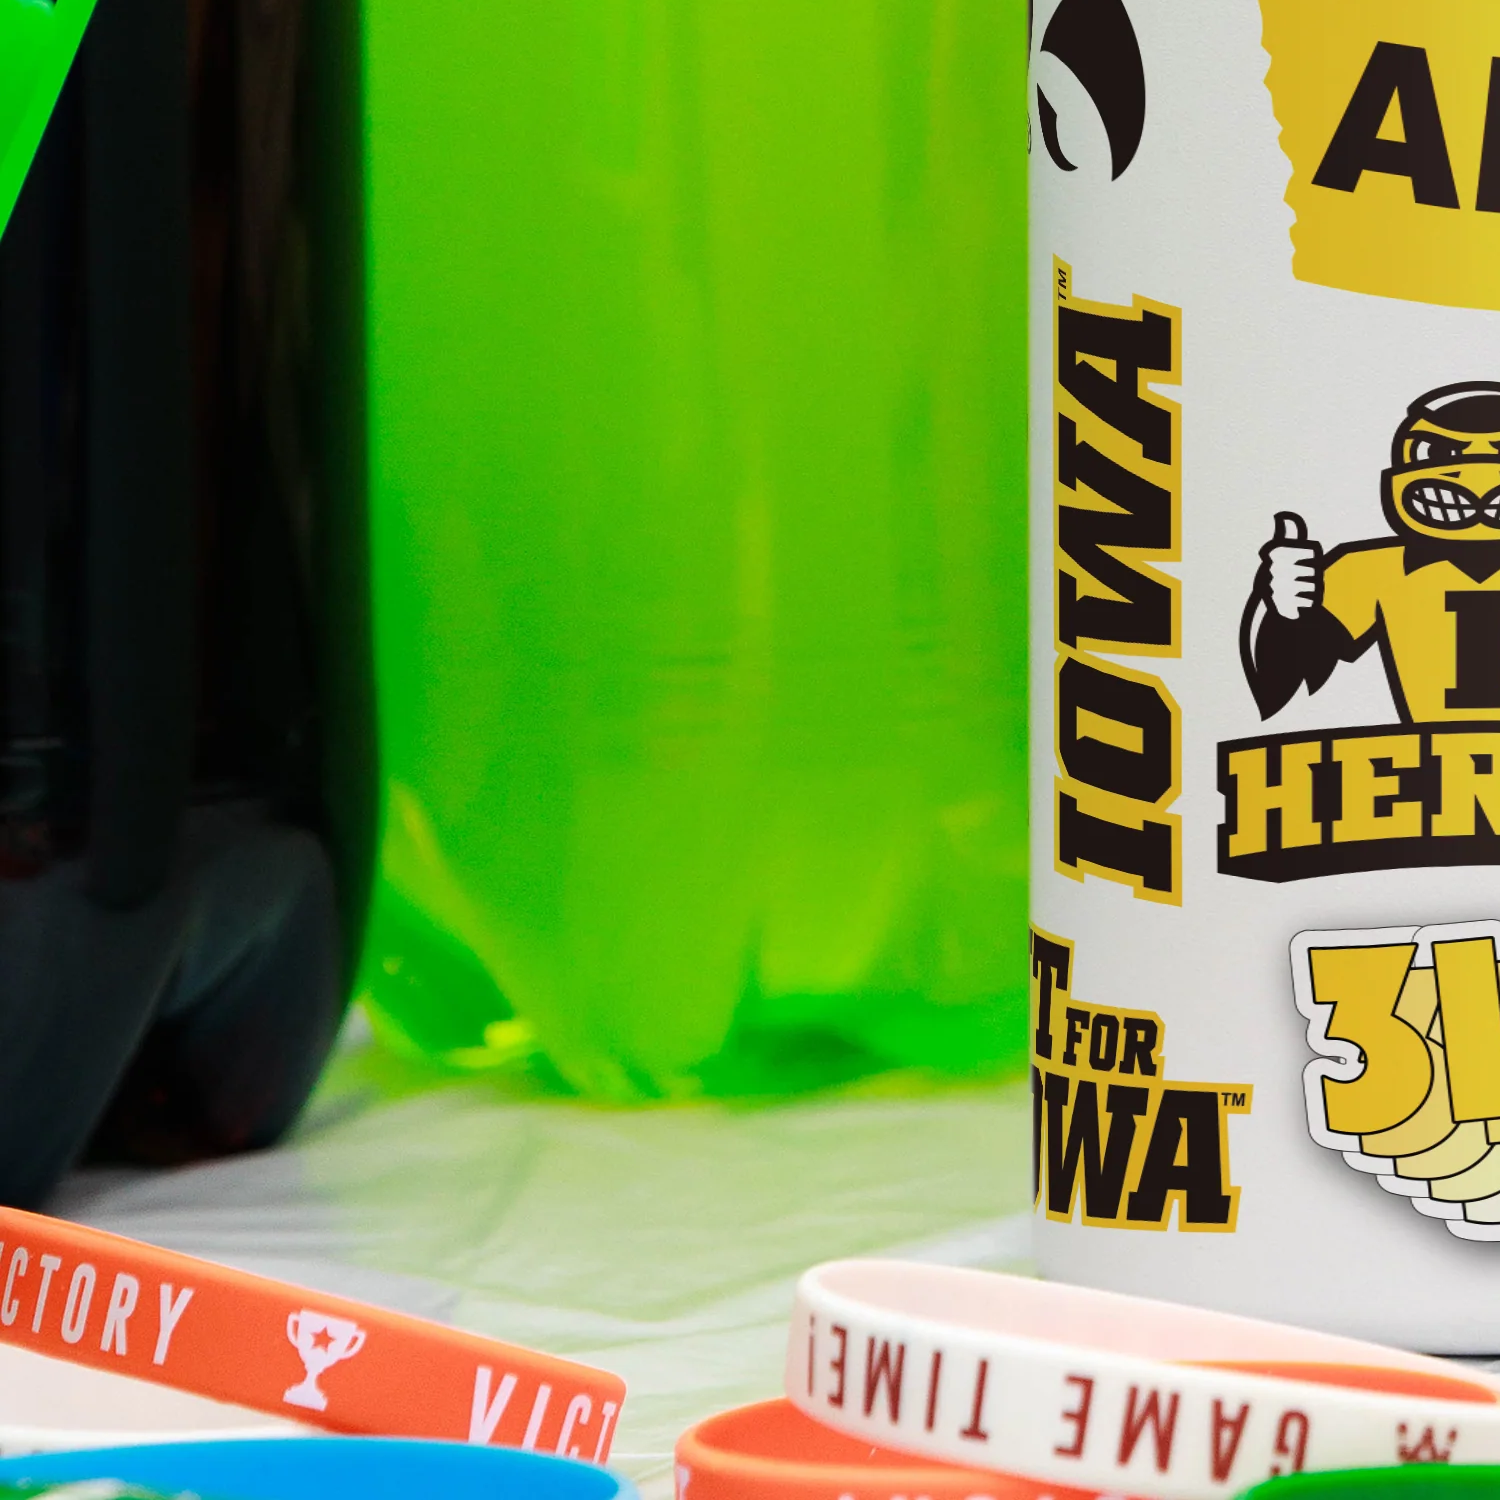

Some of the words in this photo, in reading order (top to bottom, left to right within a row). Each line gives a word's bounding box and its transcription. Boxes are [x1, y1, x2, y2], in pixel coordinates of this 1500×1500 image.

[1056, 300, 1176, 898] IOWA
[1062, 1006, 1158, 1077] FOR
[0, 1241, 196, 1367] CTORY
[807, 1311, 991, 1443] TIME!
[1053, 1371, 1311, 1484] GAME
